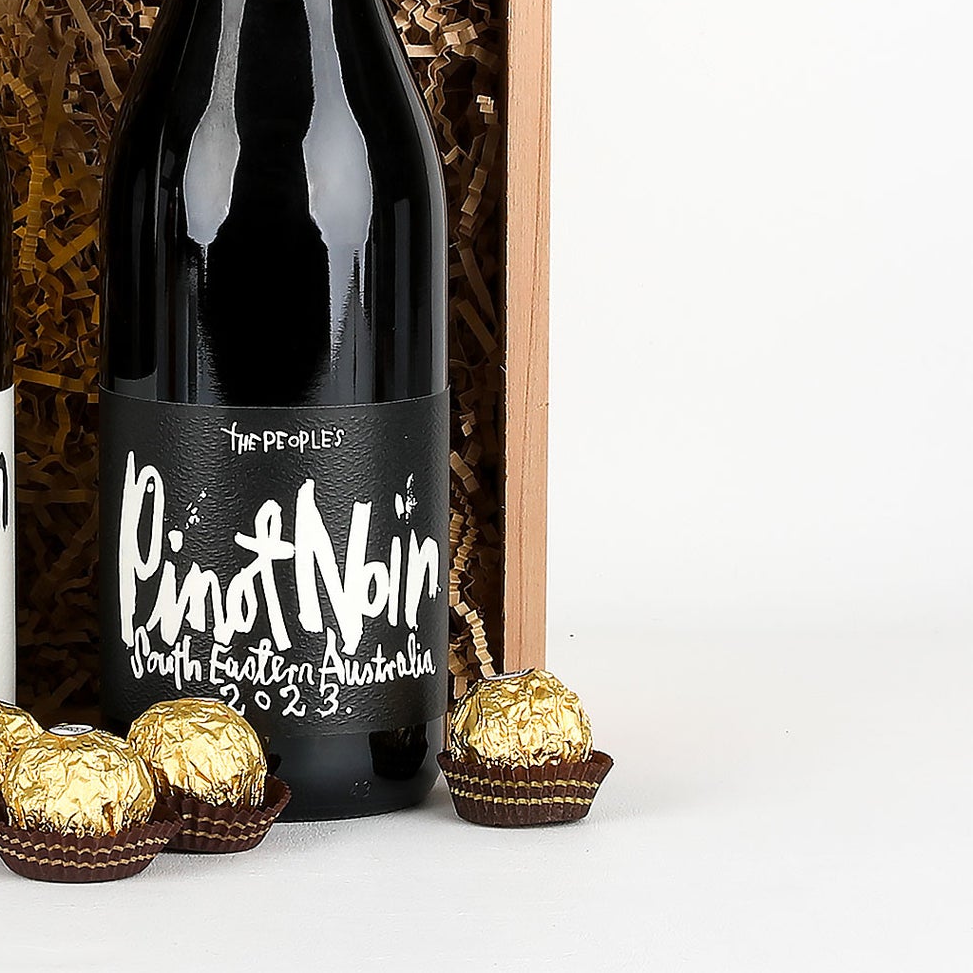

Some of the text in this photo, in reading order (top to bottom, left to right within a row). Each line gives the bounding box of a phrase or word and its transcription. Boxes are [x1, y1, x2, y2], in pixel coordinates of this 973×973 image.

[221, 422, 345, 455] THE PEOPLE'S
[119, 450, 442, 656] Pinot Noir
[130, 626, 437, 691] South Eastern Australia
